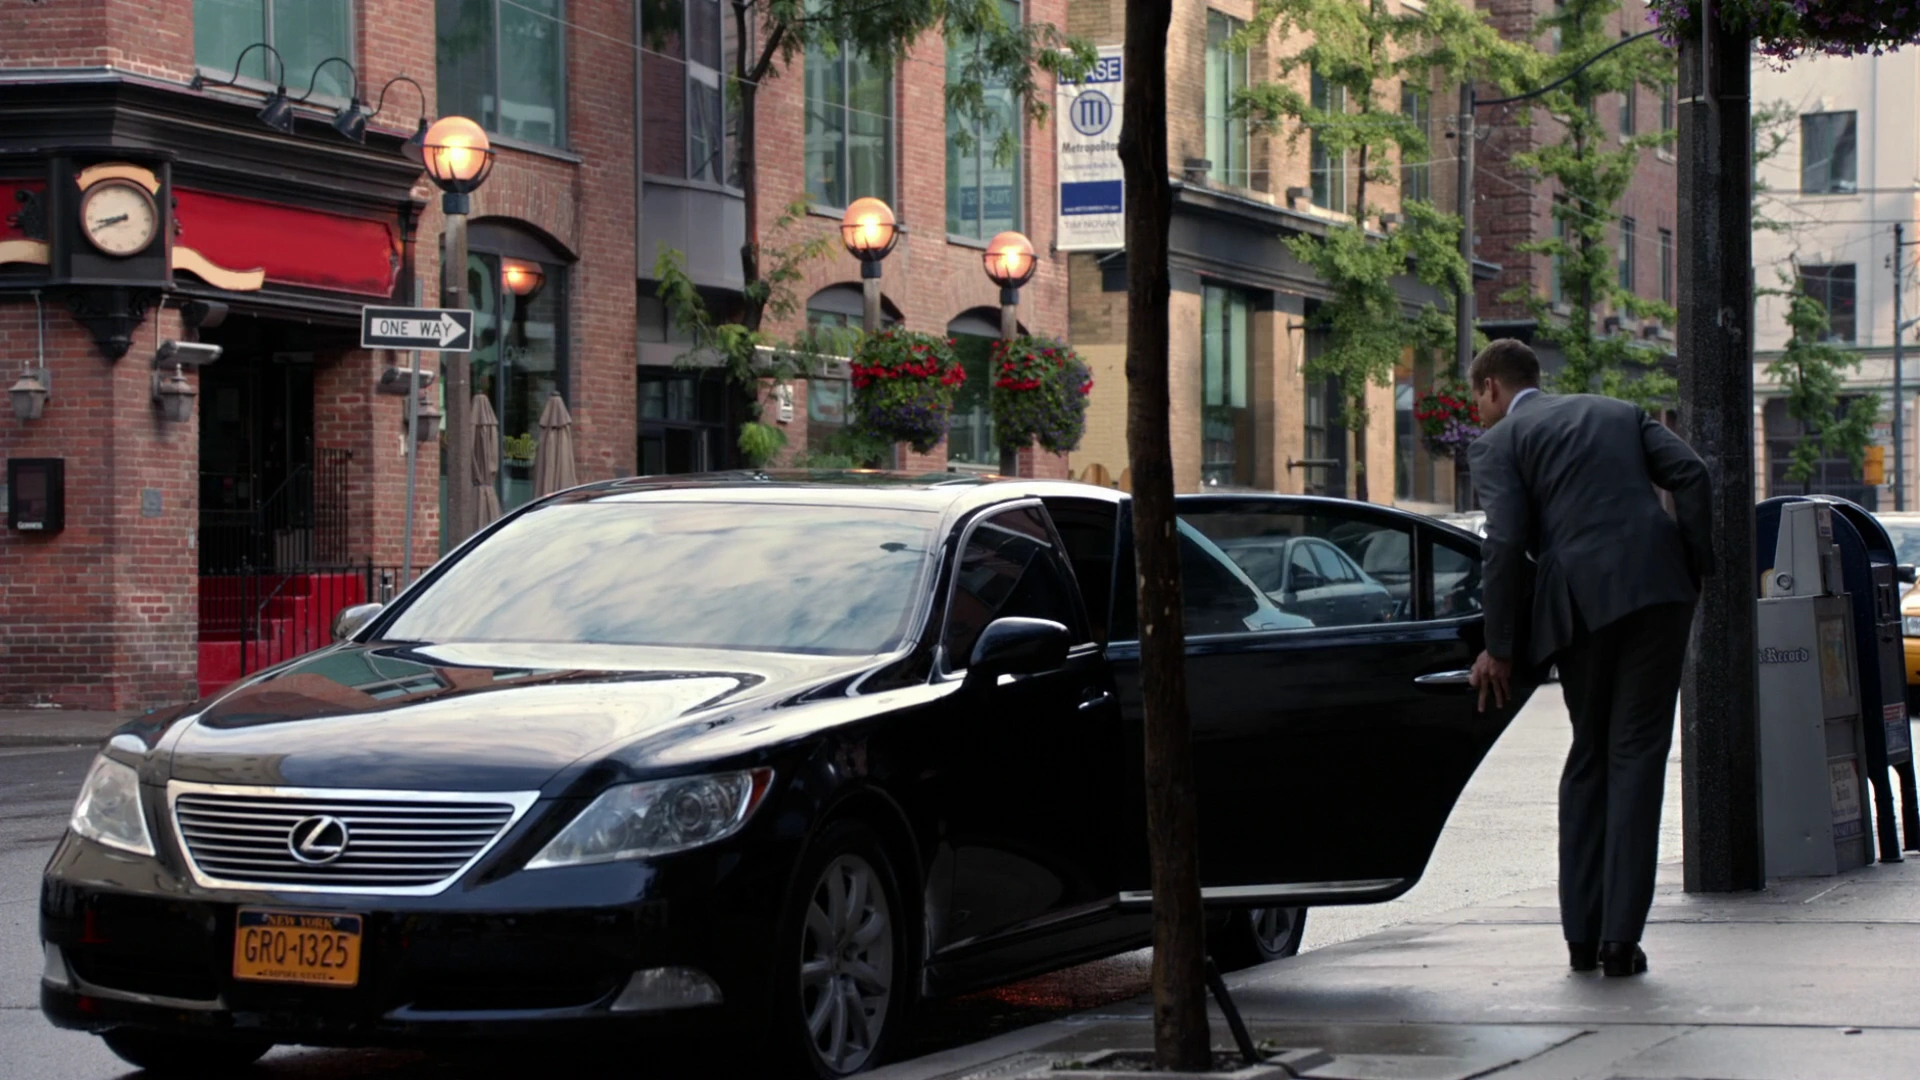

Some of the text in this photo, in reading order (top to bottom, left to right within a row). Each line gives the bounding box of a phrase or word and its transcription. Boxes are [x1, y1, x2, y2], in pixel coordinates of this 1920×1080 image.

[1061, 140, 1119, 155] Metropolita
[380, 320, 453, 337] ONE WAY
[1764, 647, 1809, 664] Record
[267, 915, 334, 930] NEW YORK
